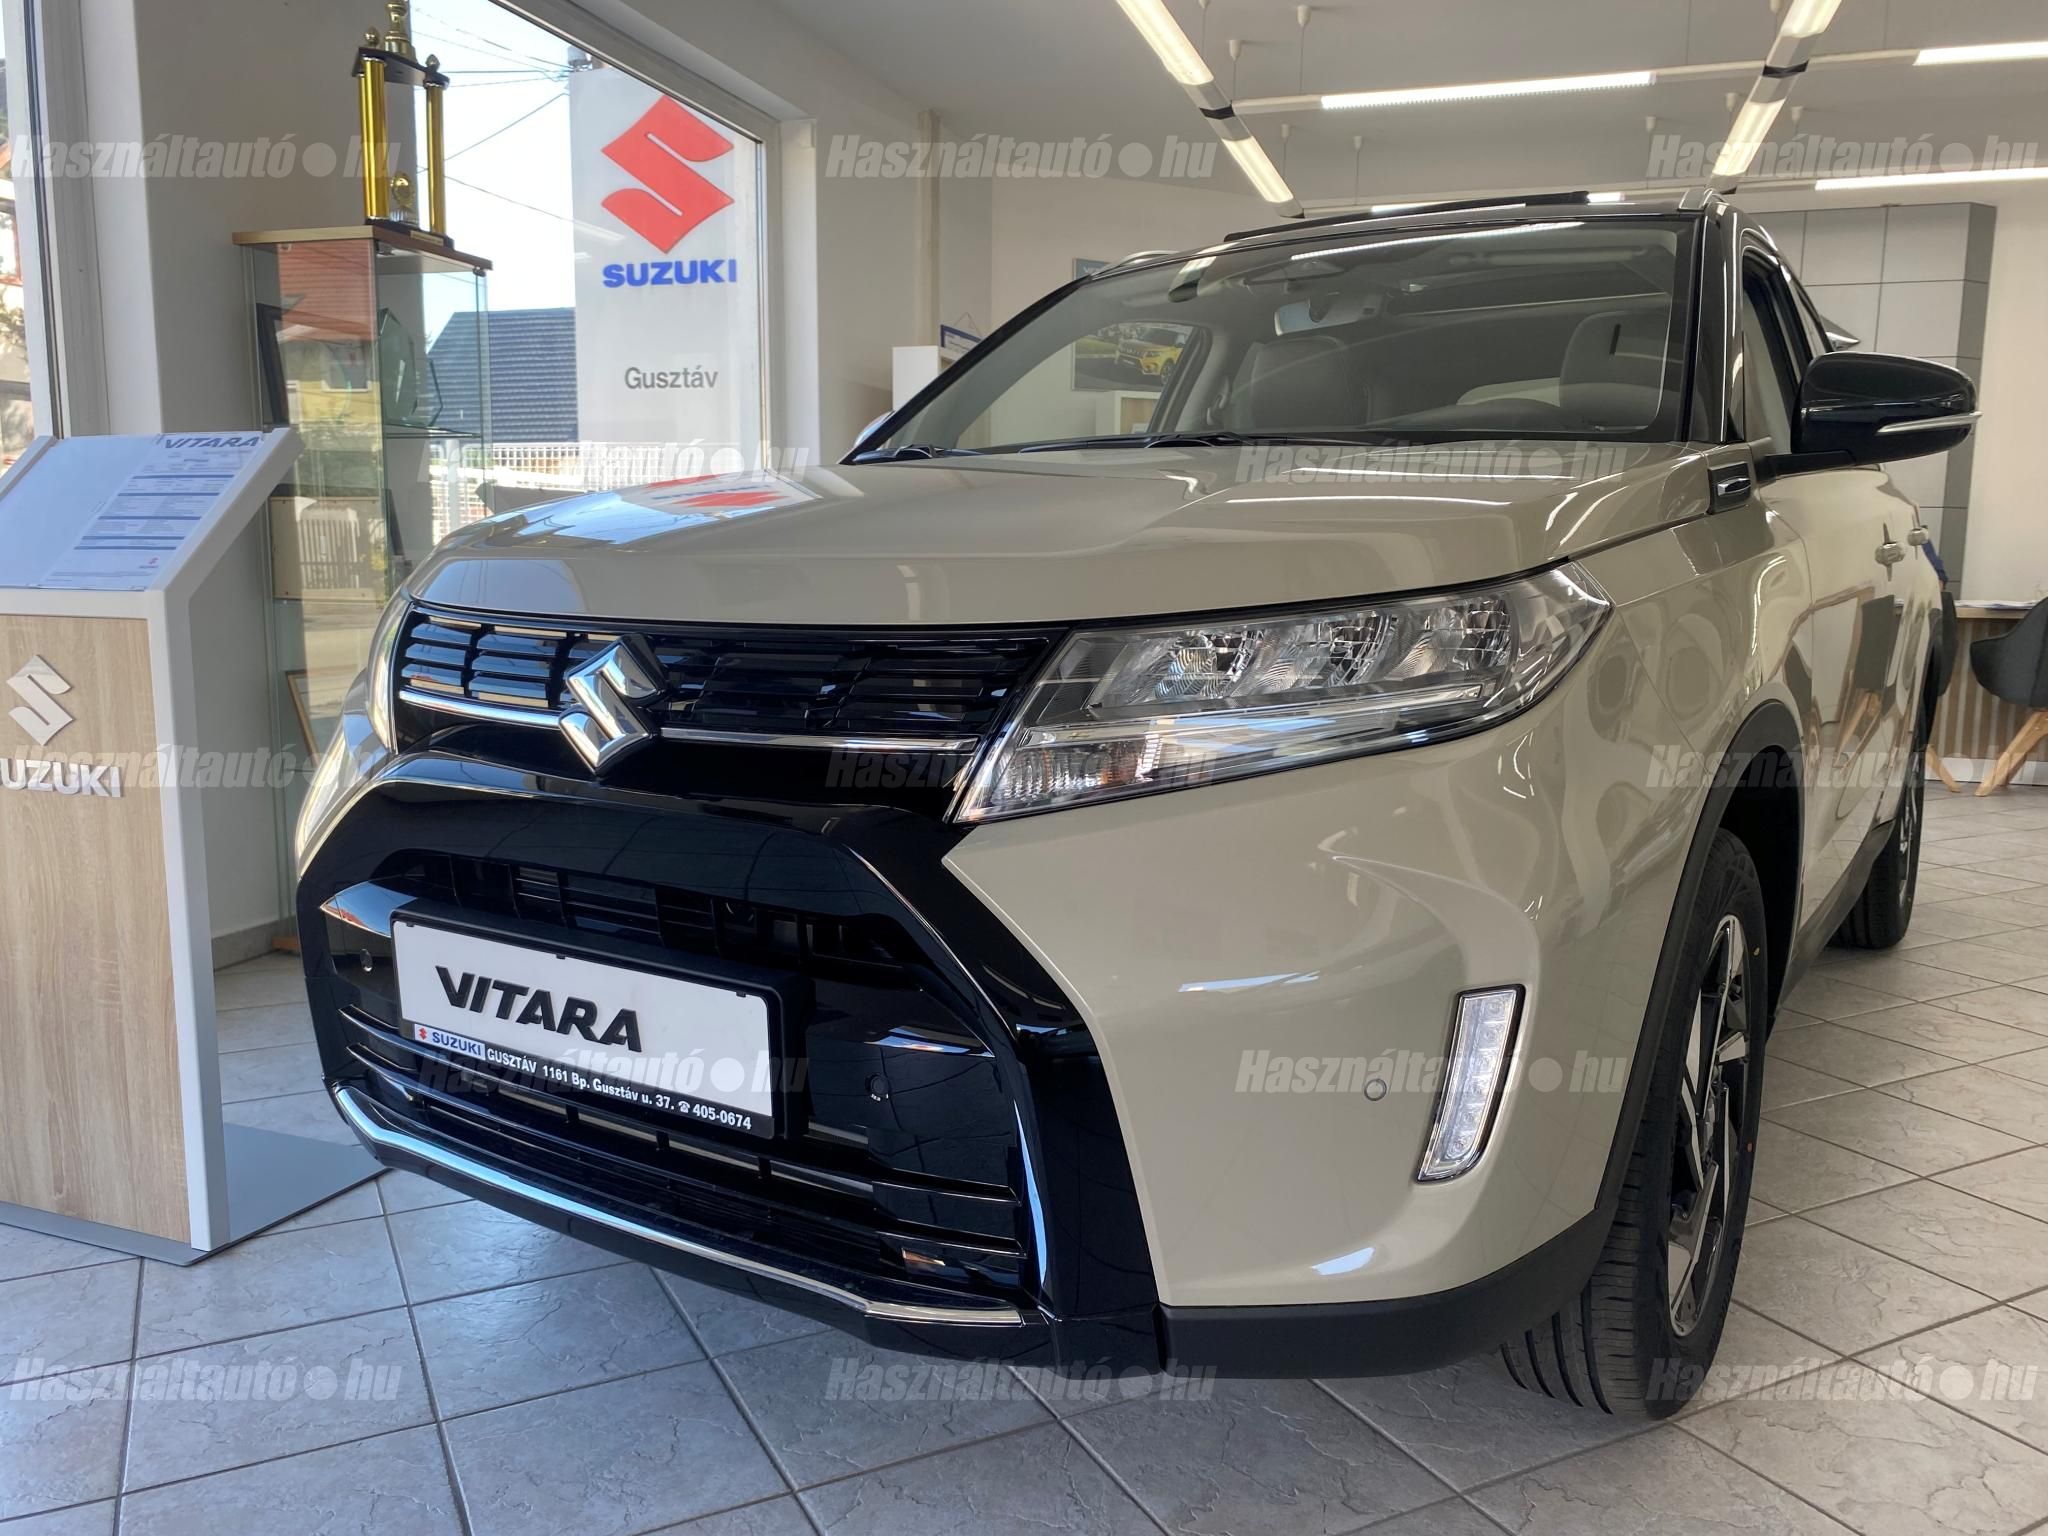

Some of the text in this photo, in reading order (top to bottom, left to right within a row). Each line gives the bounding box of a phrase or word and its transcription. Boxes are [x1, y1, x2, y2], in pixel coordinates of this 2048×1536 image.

[602, 259, 737, 288] SUZUKI
[624, 365, 719, 390] Gusztáv
[164, 436, 261, 449] VITARA
[0, 757, 121, 798] UZUKI
[435, 965, 643, 1053] VITARA
[432, 1031, 752, 1130] SUZUKI GUSZTÁV 1161 Bp. Gusztáv u. 37. 405-0674
